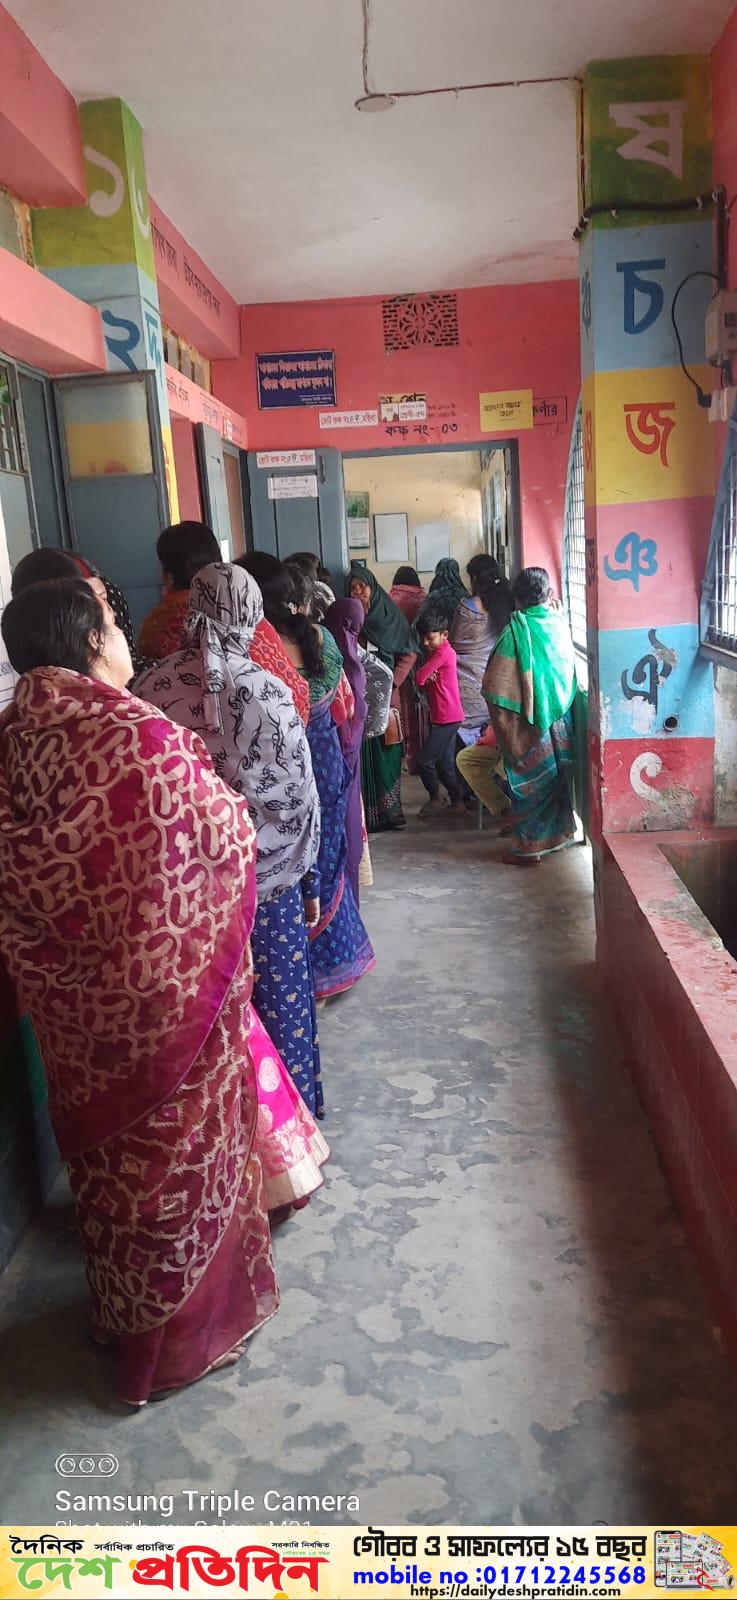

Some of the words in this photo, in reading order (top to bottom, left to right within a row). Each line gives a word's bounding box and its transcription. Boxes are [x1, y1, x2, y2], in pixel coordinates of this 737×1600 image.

[83, 145, 124, 218] ১
[616, 258, 666, 335] চ
[102, 310, 140, 372] ২
[624, 402, 677, 467] জ
[604, 532, 658, 592] ঞ
